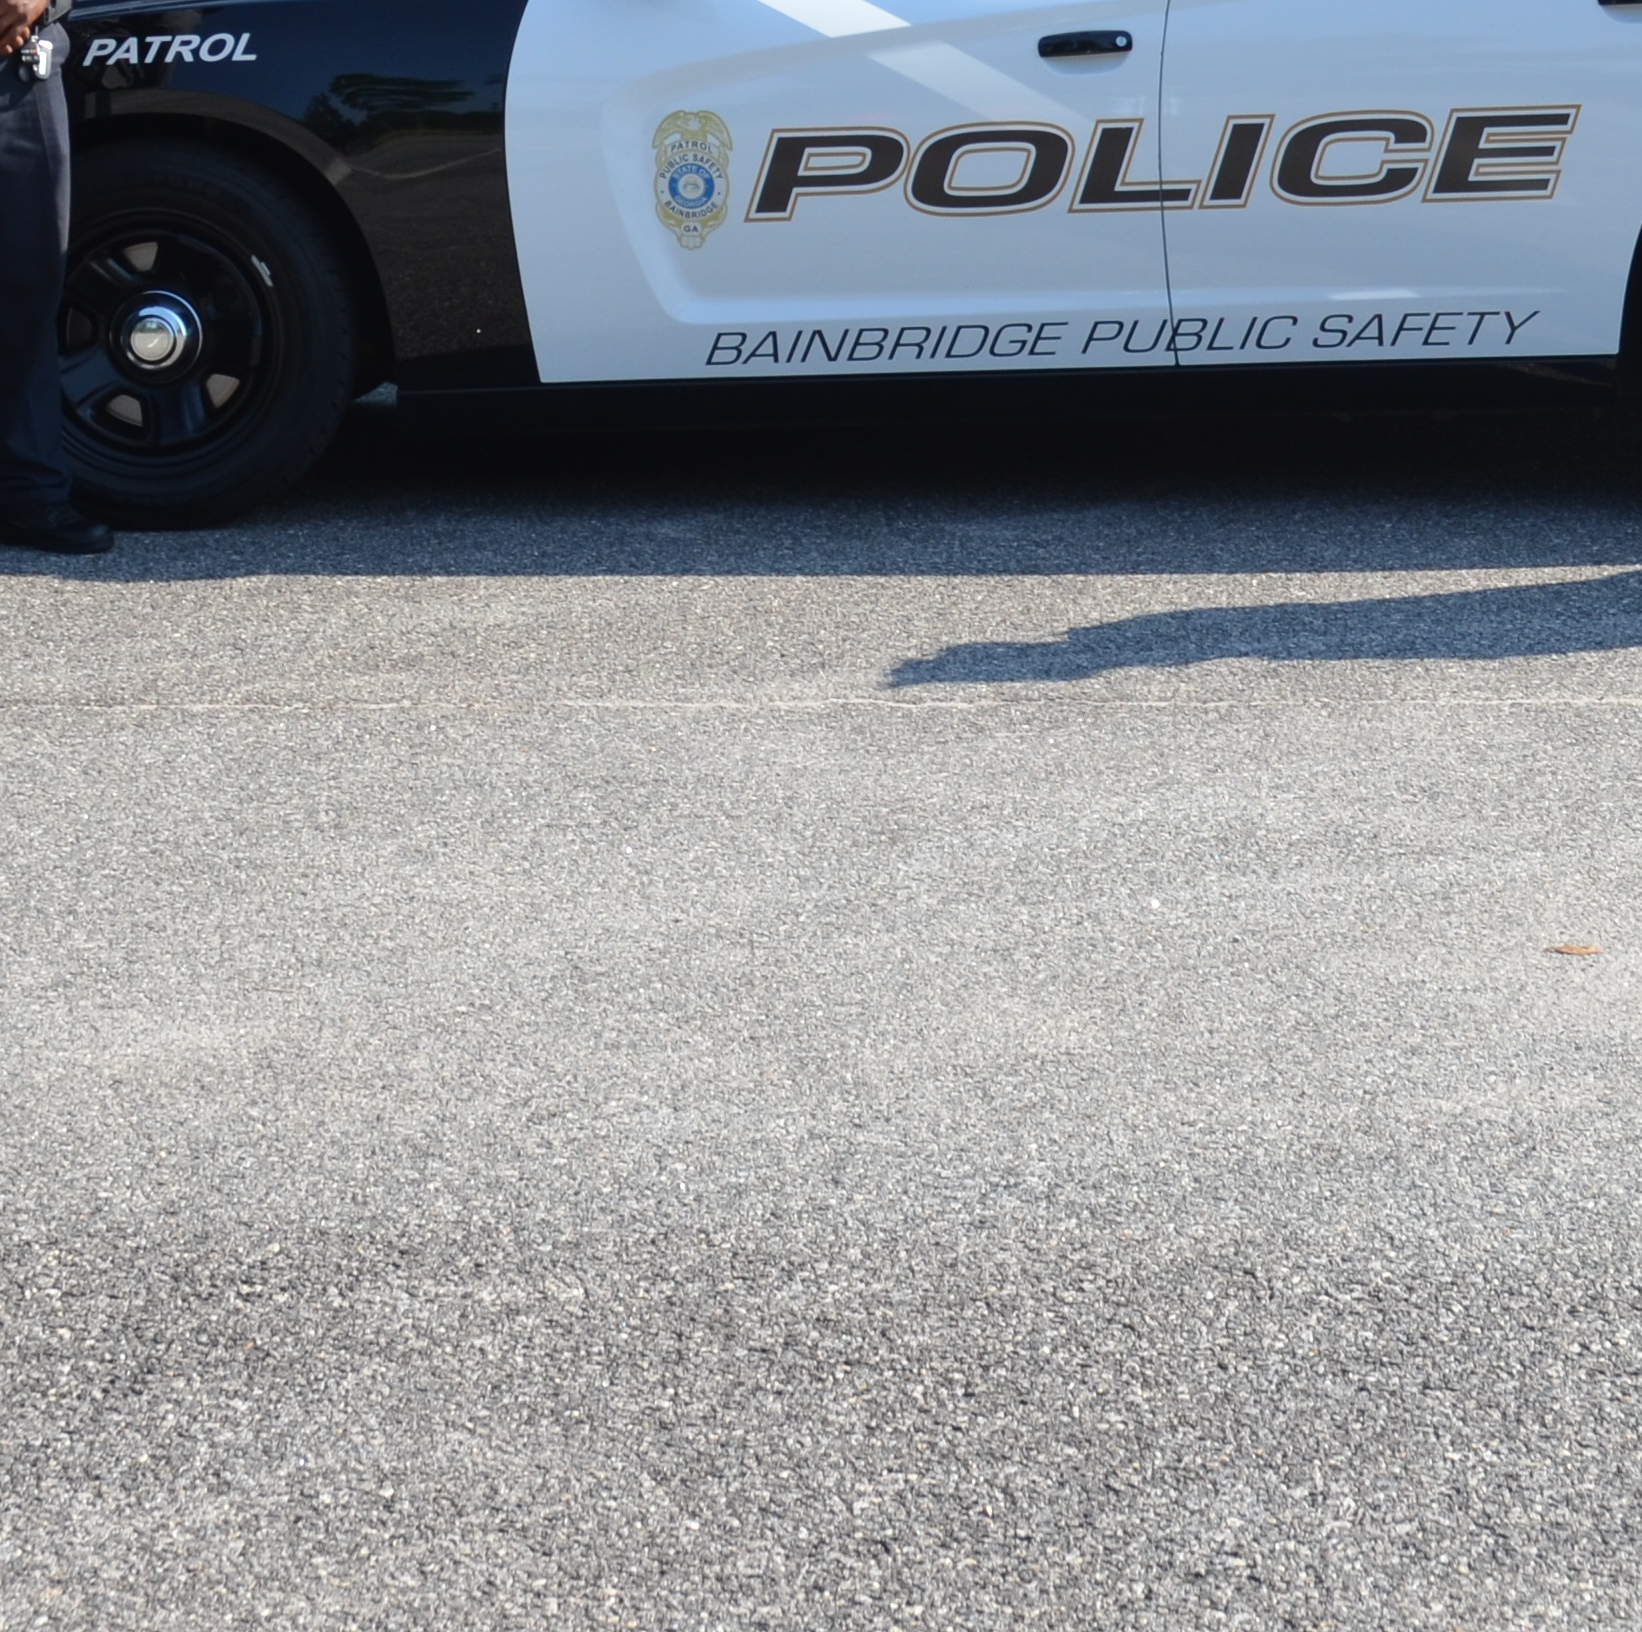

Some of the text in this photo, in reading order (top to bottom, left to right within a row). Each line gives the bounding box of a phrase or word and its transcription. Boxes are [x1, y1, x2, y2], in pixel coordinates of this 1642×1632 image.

[83, 32, 258, 67] PATROL
[670, 140, 714, 154] PATROL
[659, 153, 724, 180] PUBLIC SAFETY
[743, 104, 1582, 223] POLICE
[664, 200, 719, 220] BAINBRIDGE
[682, 225, 699, 234] GA
[704, 310, 1541, 367] BAINBRIDGE PUBLIC SAFETY
